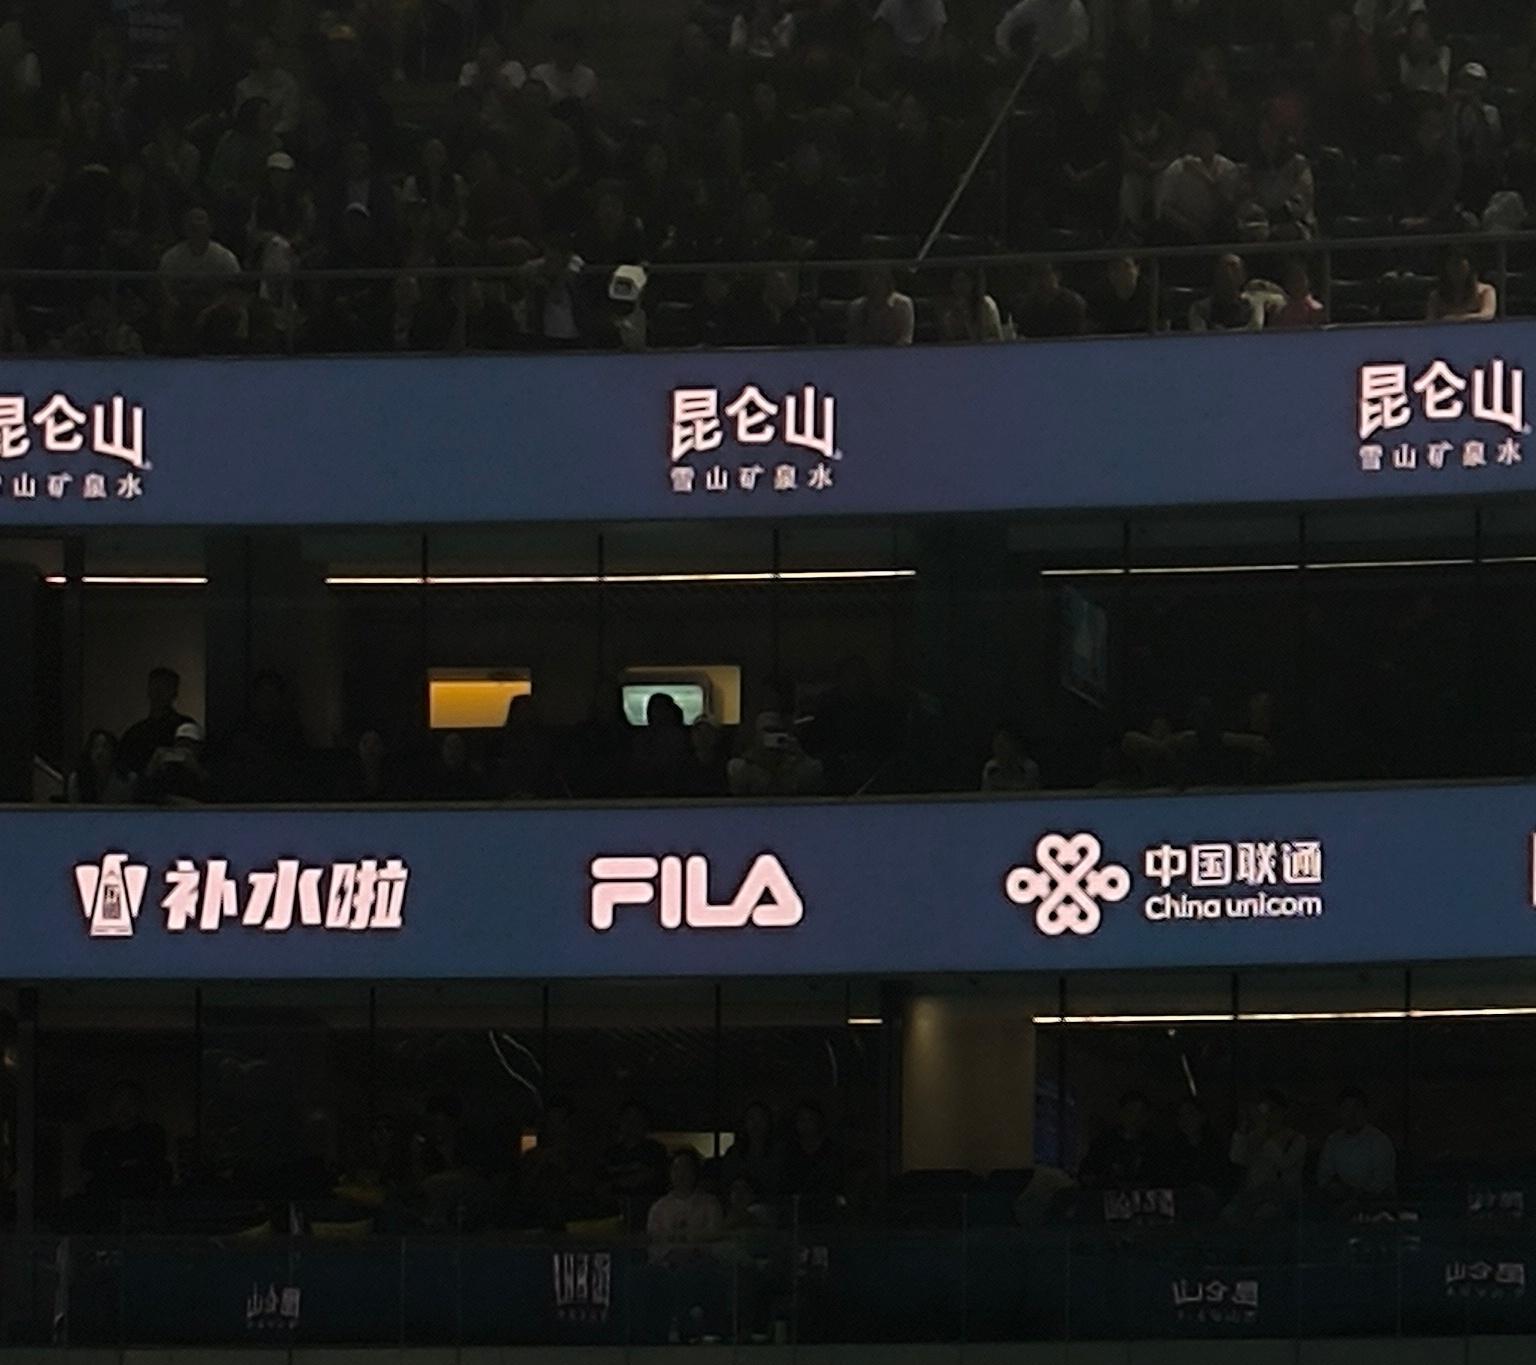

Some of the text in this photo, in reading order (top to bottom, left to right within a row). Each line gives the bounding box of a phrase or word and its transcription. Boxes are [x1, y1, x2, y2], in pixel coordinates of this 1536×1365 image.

[671, 386, 838, 460] 昆仑山
[1359, 359, 1526, 440] 昆仑山
[0, 394, 145, 468] 昆仑山
[1359, 438, 1523, 471] 雪山矿泉水
[0, 472, 143, 499] 山矿泉水
[671, 463, 834, 492] 雪山矿泉水
[591, 853, 804, 930] FILA
[1145, 840, 1322, 886] 中国联通
[160, 858, 409, 931] 补水啦
[1144, 891, 1322, 920] China unicom
